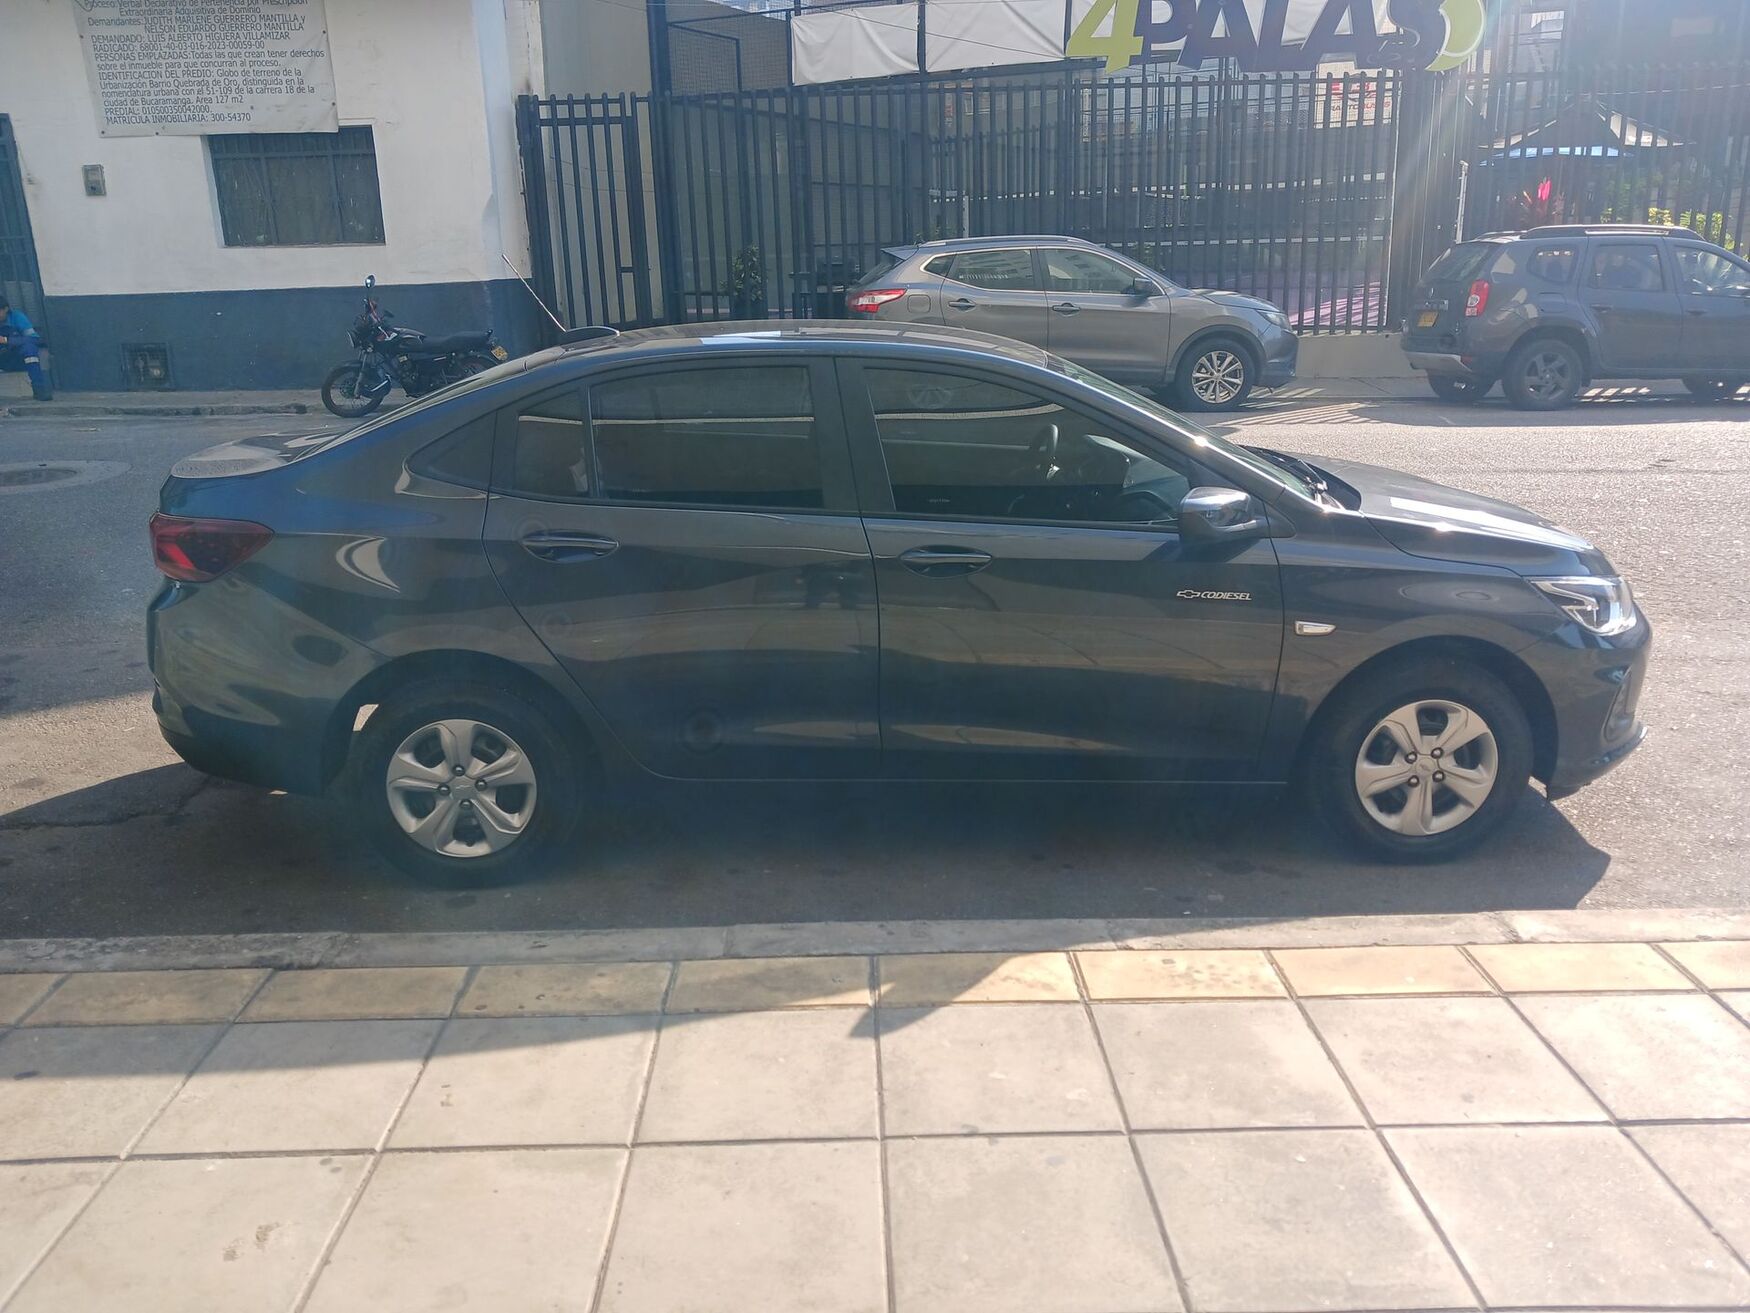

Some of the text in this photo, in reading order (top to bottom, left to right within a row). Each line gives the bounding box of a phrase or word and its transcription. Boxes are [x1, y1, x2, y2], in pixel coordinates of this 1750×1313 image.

[120, 8, 173, 16] Extraordinaria
[217, 6, 228, 14] de
[230, 6, 261, 14] Dominio
[175, 15, 211, 24] MARLENE
[214, 14, 257, 23] GUERRERO
[259, 14, 299, 22] MANTILLA
[145, 22, 304, 33] NELSON EDUARDO GUERRERO MANTILLA
[91, 31, 290, 43] DEMANDADO: LUIS ALBERTO HIGUERA VILLAMIZAR
[93, 43, 137, 52] RADICADO:
[95, 52, 135, 61] PERSONAS
[215, 50, 225, 58] las
[228, 51, 242, 60] que
[244, 50, 265, 58] crean
[267, 50, 287, 58] tener
[290, 49, 324, 58] derechos
[97, 59, 281, 71] sobre el inmueble para que concurran al proceso.
[165, 70, 180, 78] DEL
[182, 69, 214, 78] PREDIO:
[217, 69, 239, 77] Globo
[241, 69, 250, 77] de
[252, 68, 280, 77] terreno
[283, 68, 292, 76] de
[294, 68, 302, 76] la
[149, 79, 171, 88] Barrio
[173, 78, 210, 88] Quebrada
[212, 78, 221, 86] de
[242, 77, 283, 87] distinguida
[297, 77, 304, 85] la
[102, 88, 151, 98] nomenclatura
[153, 88, 179, 97] urbana
[235, 86, 244, 94] de
[246, 86, 254, 94] la
[285, 85, 294, 94] 18
[297, 85, 306, 94] de
[308, 85, 315, 93] la
[104, 98, 128, 107] ciudad
[130, 98, 139, 106] de
[215, 95, 229, 103] 127
[105, 107, 140, 116] PREDIAL:
[106, 113, 251, 125] MATRICULA INMOBILIARIA: 300-54370
[1201, 591, 1252, 600] CODIESEL
